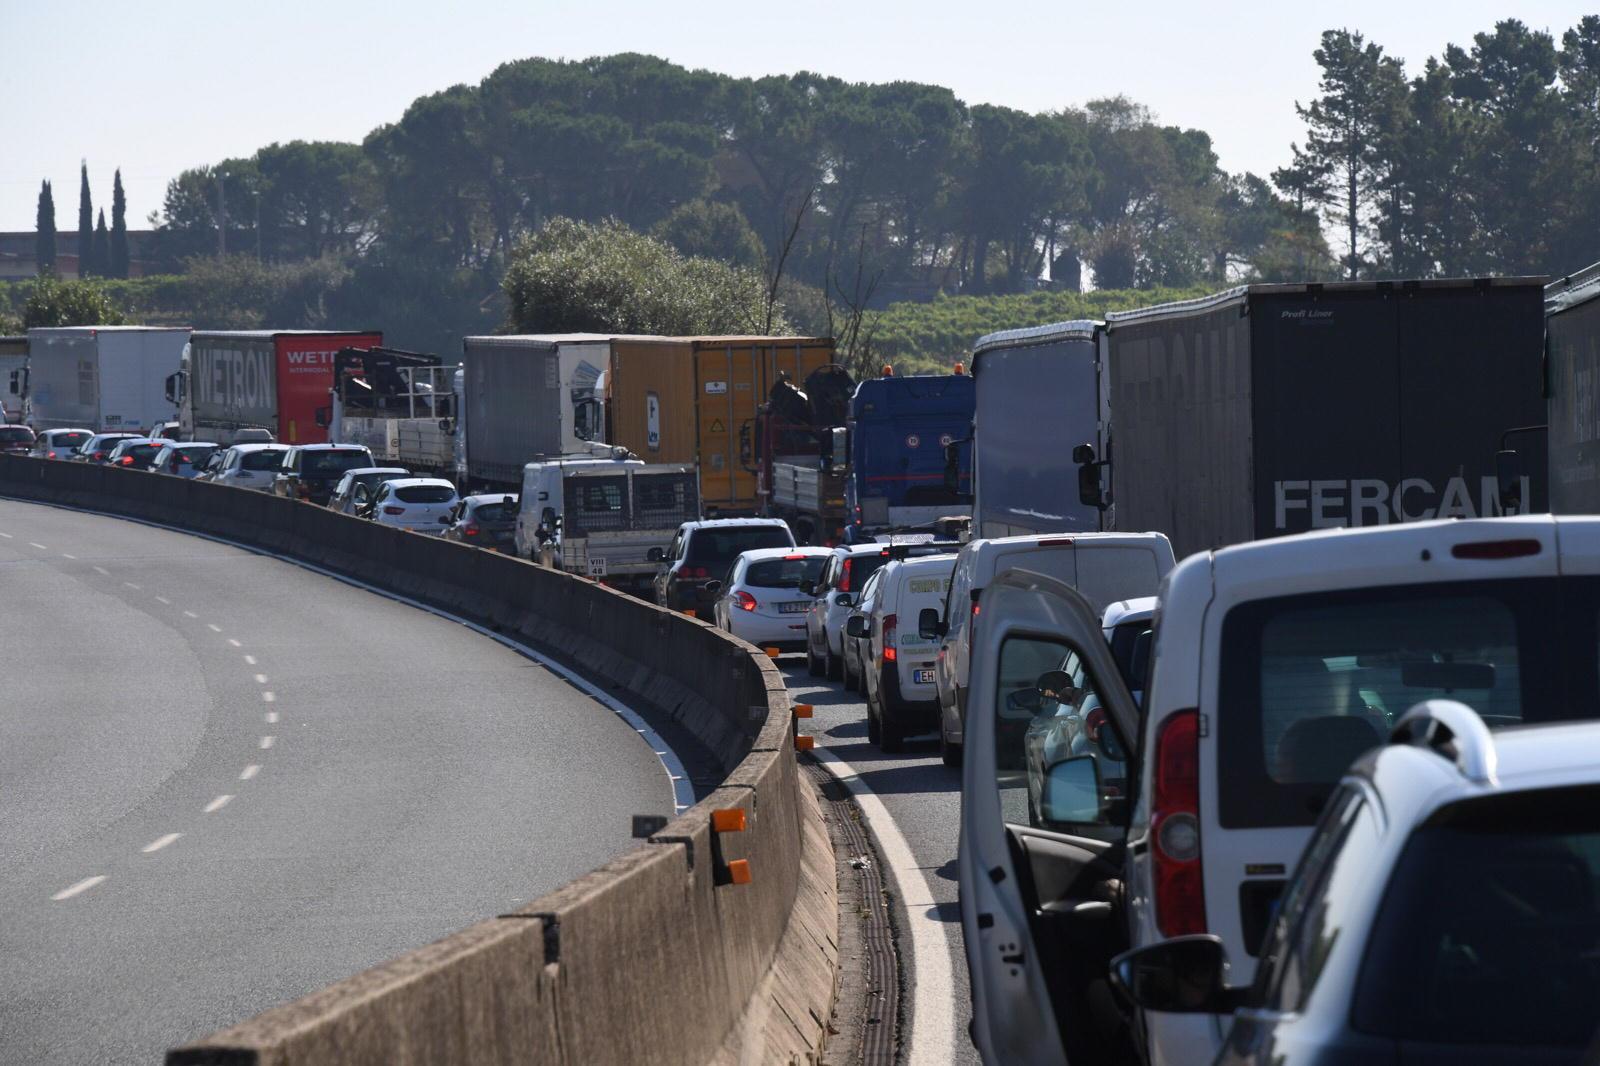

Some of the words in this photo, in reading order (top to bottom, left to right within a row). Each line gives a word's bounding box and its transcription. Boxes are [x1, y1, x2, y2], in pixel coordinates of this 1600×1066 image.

[1281, 310, 1306, 318] Profi
[197, 349, 271, 408] WETRON
[921, 671, 934, 681] EH
